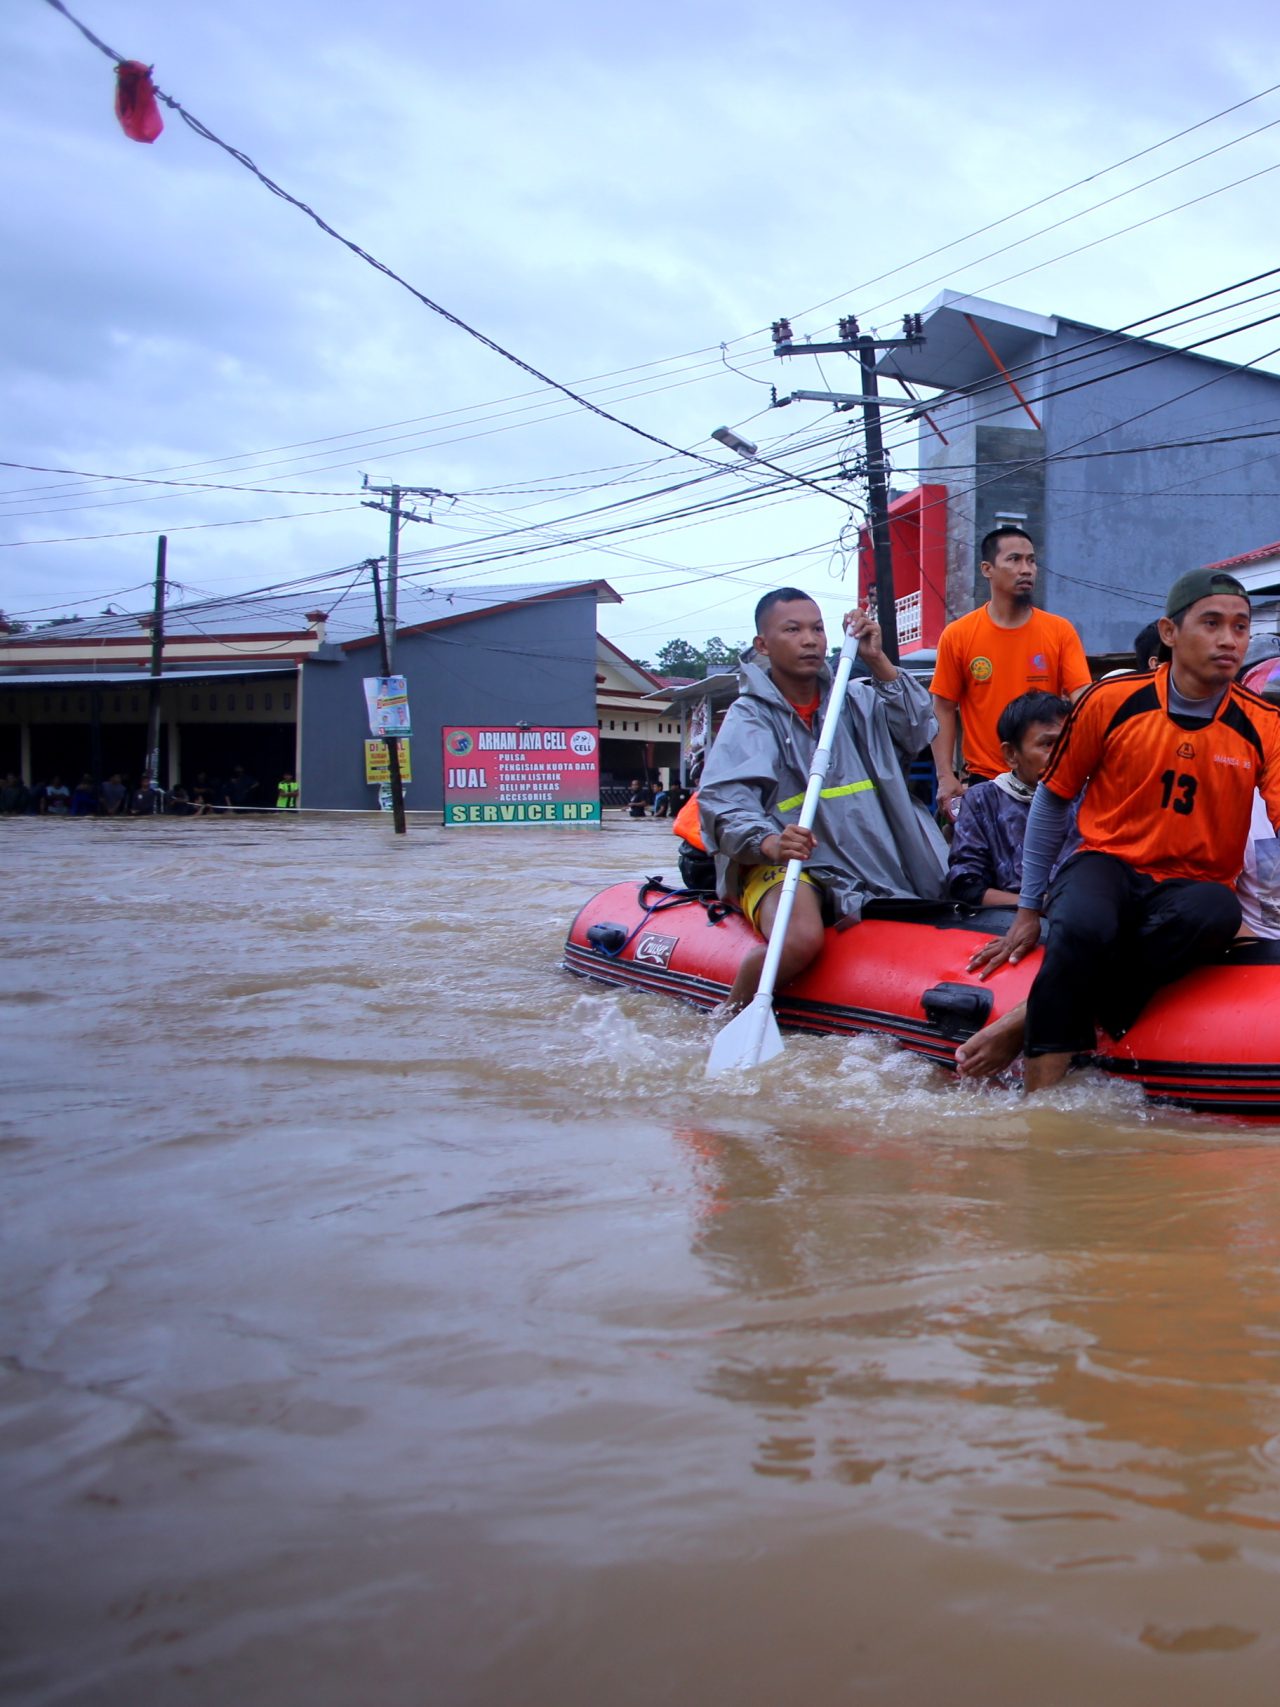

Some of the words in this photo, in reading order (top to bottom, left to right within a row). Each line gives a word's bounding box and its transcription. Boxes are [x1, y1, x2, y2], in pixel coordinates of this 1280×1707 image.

[478, 732, 517, 750] ARHAM
[519, 732, 542, 750] JAYA
[543, 732, 567, 750] CELL
[574, 744, 592, 752] CELL
[499, 753, 526, 761] PULSA
[499, 763, 545, 771] PENGISIAN
[546, 763, 574, 771] KUOTA
[575, 762, 596, 771] DATA
[448, 768, 488, 788] JUAL
[499, 773, 527, 781] TOKEN
[528, 773, 561, 781] LISTRIK
[500, 783, 518, 791] BELI
[519, 783, 531, 791] HP
[532, 782, 560, 791] BEKAS
[500, 793, 553, 801] ACCESORIES
[1160, 769, 1198, 816] 13
[452, 804, 556, 822] SERVICE
[563, 803, 594, 819] HP
[636, 936, 669, 965] Cruiser
